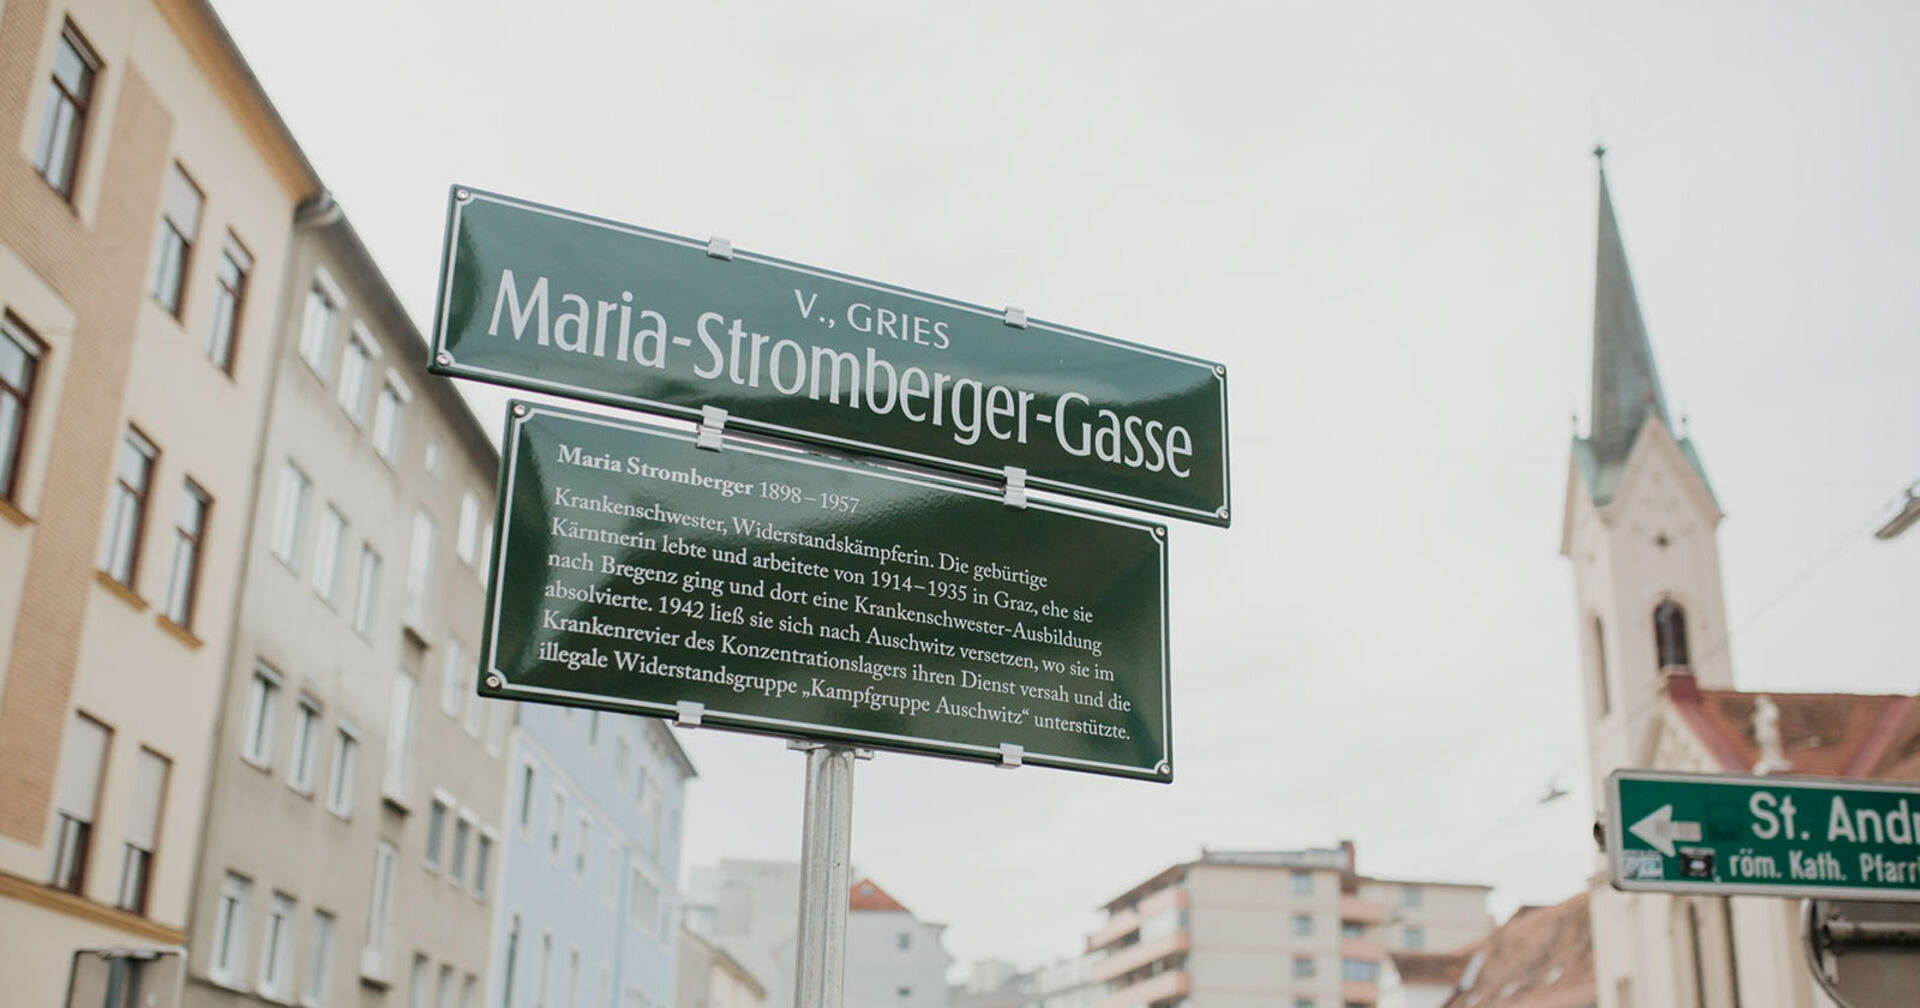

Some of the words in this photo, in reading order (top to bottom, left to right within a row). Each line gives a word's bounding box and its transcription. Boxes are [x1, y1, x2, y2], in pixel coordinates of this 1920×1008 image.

[793, 289, 836, 328] V.,
[847, 302, 950, 350] GRIES
[488, 269, 1192, 478] Maria-Stromberger-Gasse
[556, 442, 622, 473] Maria
[625, 455, 754, 498] Stromberger
[550, 515, 657, 551] Kärntnerin
[660, 533, 707, 560] lebte
[710, 545, 748, 566] und
[751, 550, 830, 579] arbeitete
[832, 567, 866, 585] von
[870, 568, 968, 602] 1914–1935
[971, 586, 989, 606] in
[992, 589, 1039, 617] Graz,
[1040, 598, 1070, 620] ehe
[1071, 604, 1094, 624] sie
[553, 486, 728, 536] Krankenschwester,
[731, 515, 935, 569] Widerstandskämpferin.
[937, 550, 970, 575] Die
[971, 560, 1048, 592] gebürtige
[543, 578, 653, 612] absolvierte.
[657, 594, 705, 620] 1942
[707, 601, 745, 626] ließ
[748, 609, 774, 630] sie
[777, 614, 815, 636] sich
[818, 622, 861, 643] nach
[863, 625, 956, 658] Auschwitz
[957, 645, 1039, 673] versetzen,
[1040, 658, 1066, 674] wo
[1068, 659, 1090, 678] sie
[1093, 662, 1115, 682] im
[546, 551, 594, 572] nach
[599, 554, 679, 586] Bregenz
[680, 569, 725, 598] ging
[727, 578, 765, 599] und
[768, 580, 809, 605] dort
[811, 590, 849, 612] eine
[852, 593, 1103, 658] Krankenschwester-Ausbildung
[537, 640, 609, 671] illegale
[611, 648, 798, 698] Widerstandsgruppe
[1032, 714, 1131, 741] unterstützte.
[541, 608, 681, 647] Krankenrevier
[682, 628, 716, 652] des
[719, 633, 908, 682] Konzentrationslagers
[910, 662, 956, 687] ihren
[959, 668, 1017, 695] Dienst
[1018, 683, 1070, 703] versah
[1072, 689, 1105, 708] und
[1106, 691, 1132, 713] die
[1730, 848, 1782, 880] röm.
[1789, 850, 1847, 881] Kath.
[1750, 792, 1810, 840] St.
